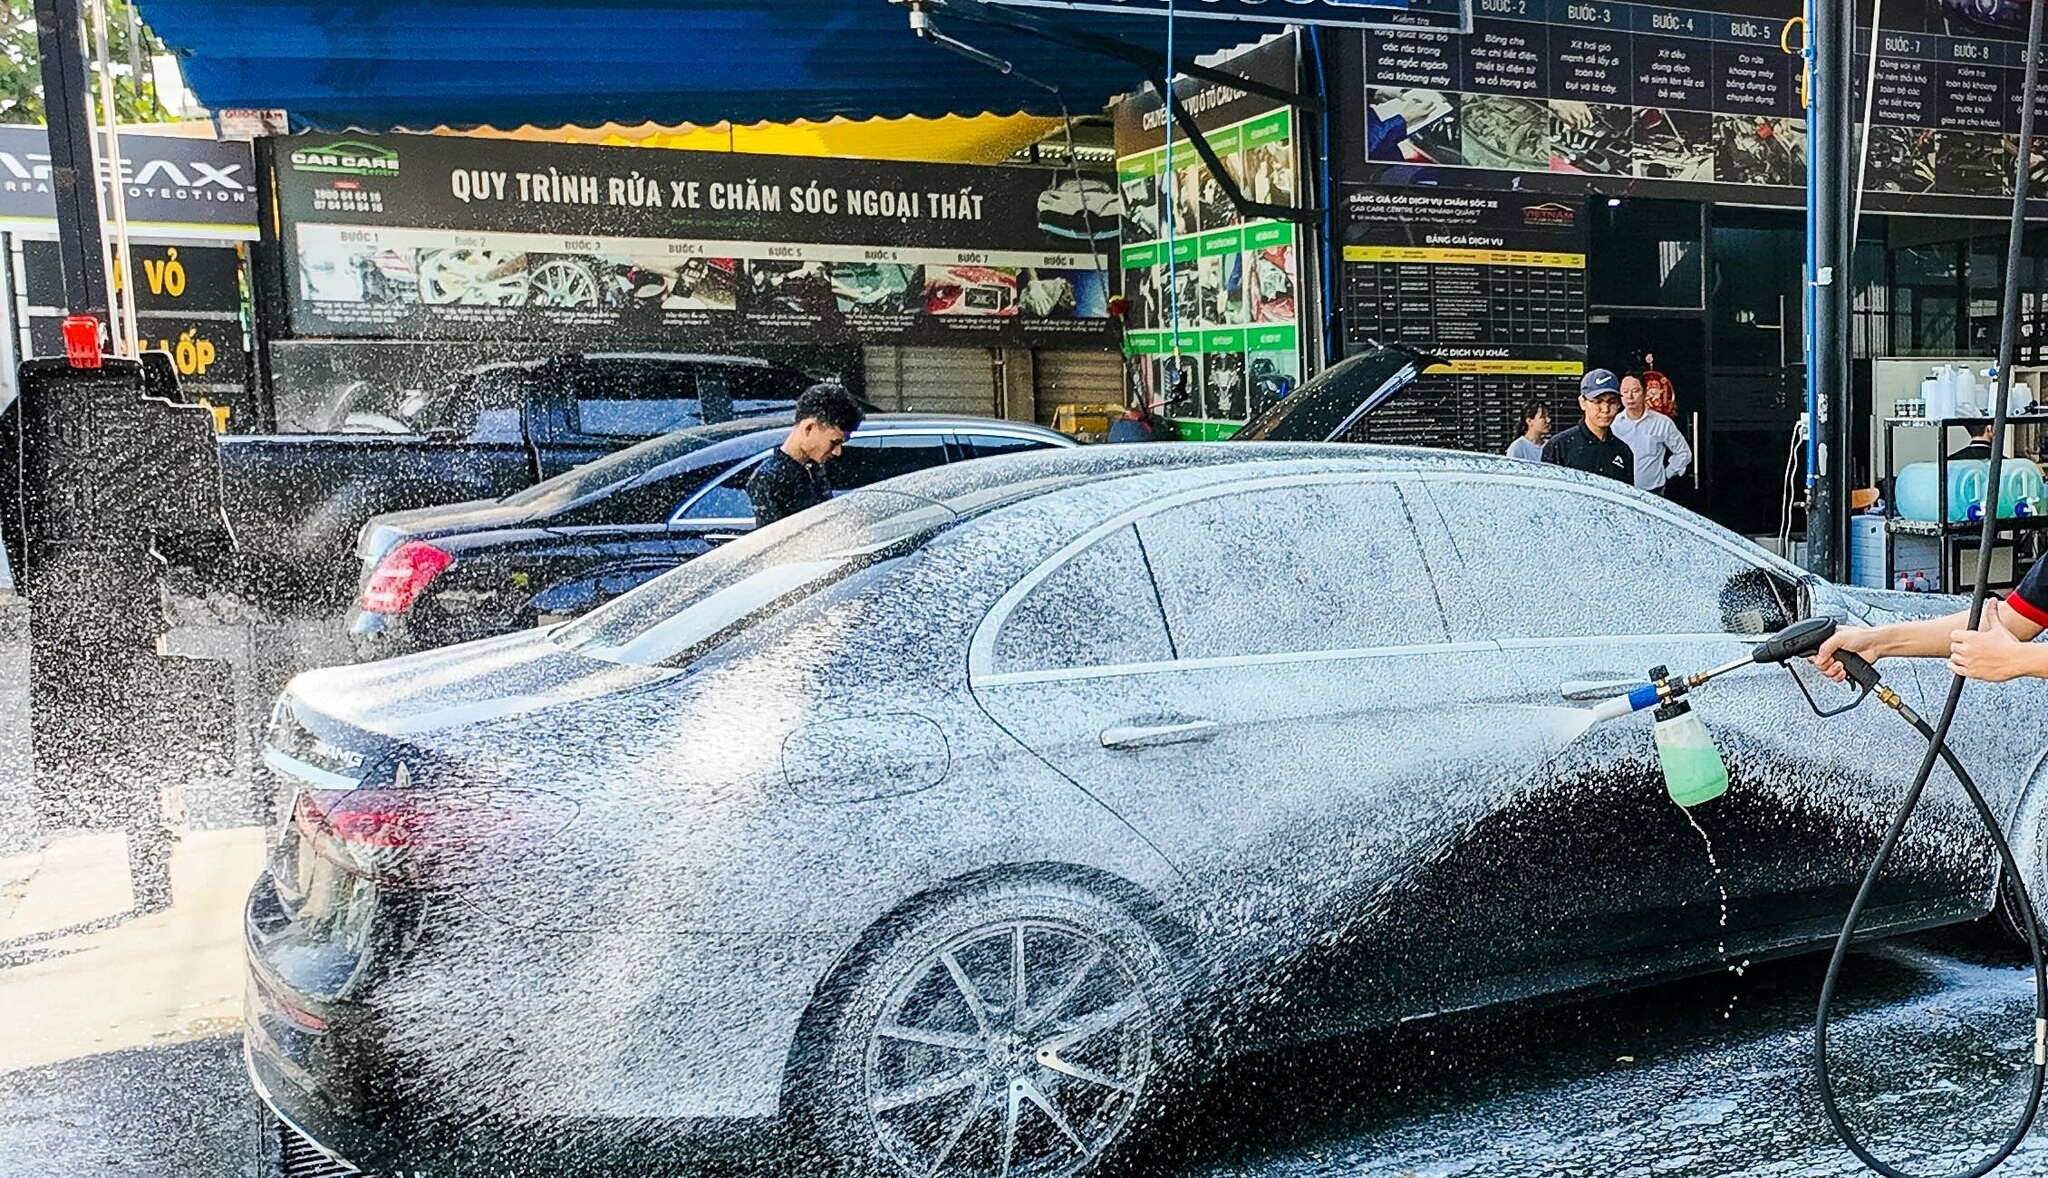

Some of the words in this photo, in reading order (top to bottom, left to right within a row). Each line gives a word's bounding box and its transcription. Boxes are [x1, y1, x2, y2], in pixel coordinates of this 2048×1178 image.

[1417, 17, 1430, 26] tra
[1603, 9, 1611, 23] 3
[1686, 18, 1694, 31] 4
[1764, 26, 1771, 39] 5
[1417, 45, 1441, 57] trong
[1983, 46, 1989, 59] 8
[1396, 71, 1429, 85] khoang
[1728, 66, 1757, 79] khoang
[291, 152, 338, 167] CAR
[341, 155, 400, 171] CARE
[451, 168, 507, 203] QUY
[515, 166, 599, 205] TRÌNH
[608, 171, 663, 208] RỬA
[670, 180, 701, 209] XE
[709, 178, 781, 212] CHĂM
[790, 180, 838, 214] SÓC
[847, 188, 919, 223] NGOẠI
[928, 186, 984, 221] THẤT
[374, 233, 379, 242] 1
[143, 248, 187, 297] VỎ
[159, 328, 216, 375] ỐP
